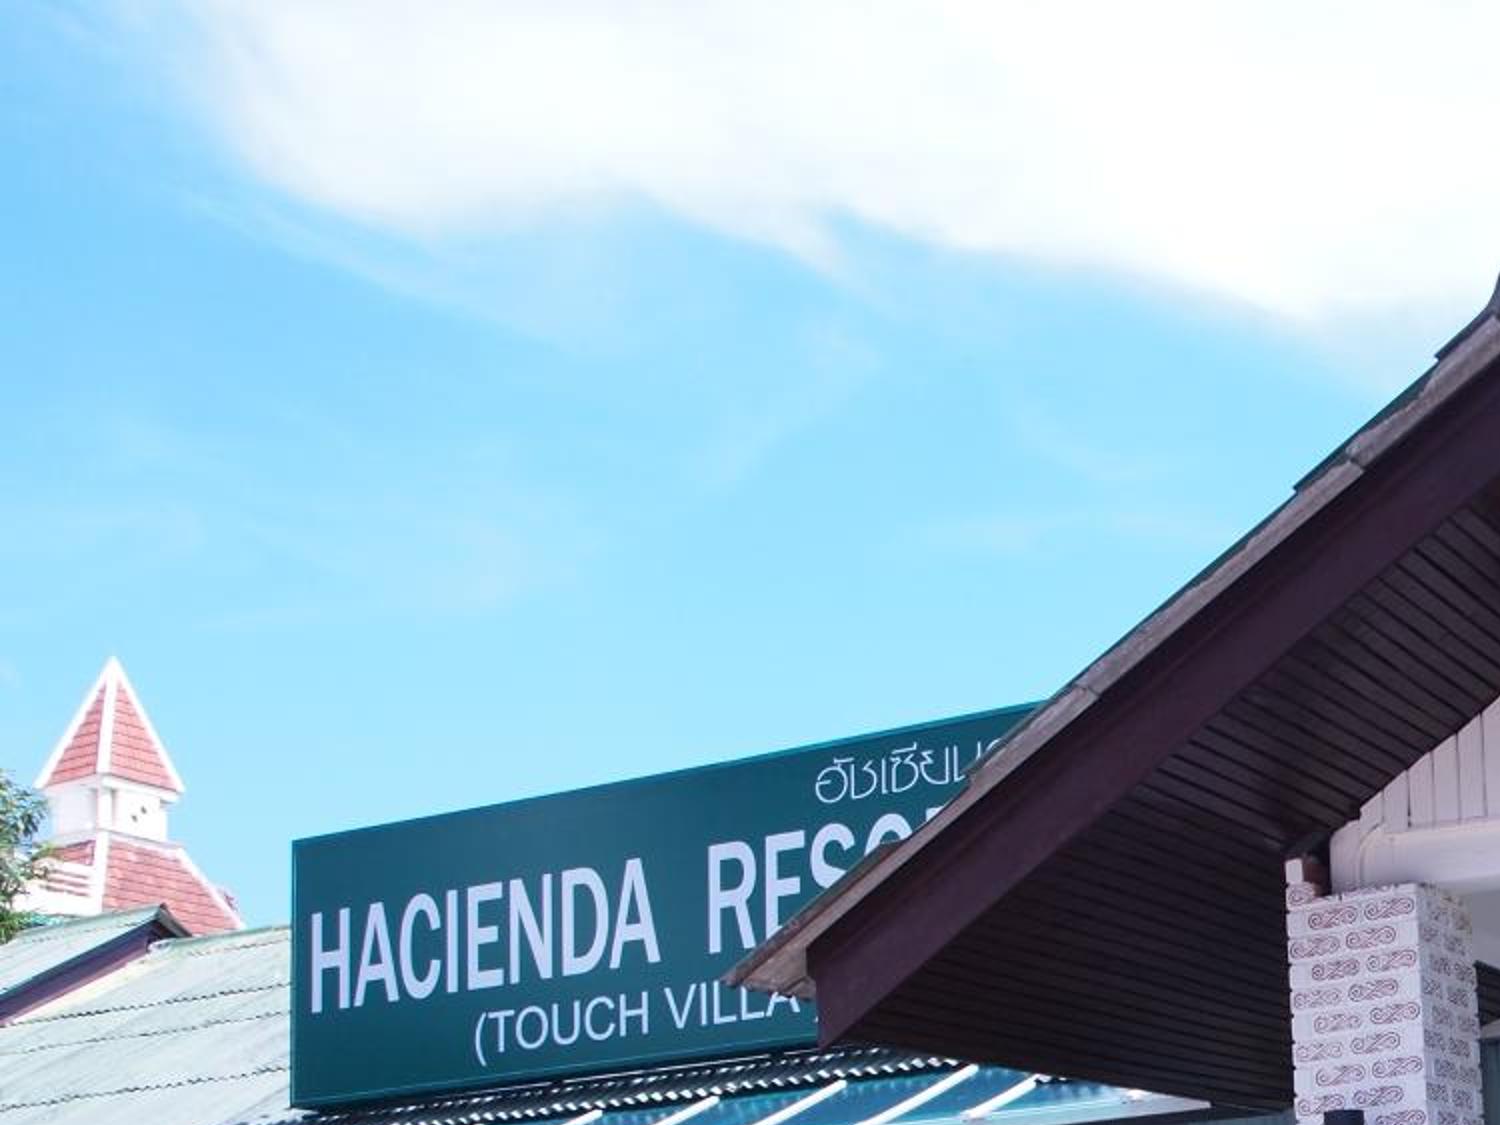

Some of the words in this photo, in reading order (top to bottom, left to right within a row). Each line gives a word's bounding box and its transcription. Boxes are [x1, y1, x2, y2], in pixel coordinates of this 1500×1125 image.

[311, 857, 661, 1013] HACIENDA
[707, 805, 949, 954] RES
[474, 990, 649, 1067] (TOUCH
[664, 979, 819, 1029] VILLA
